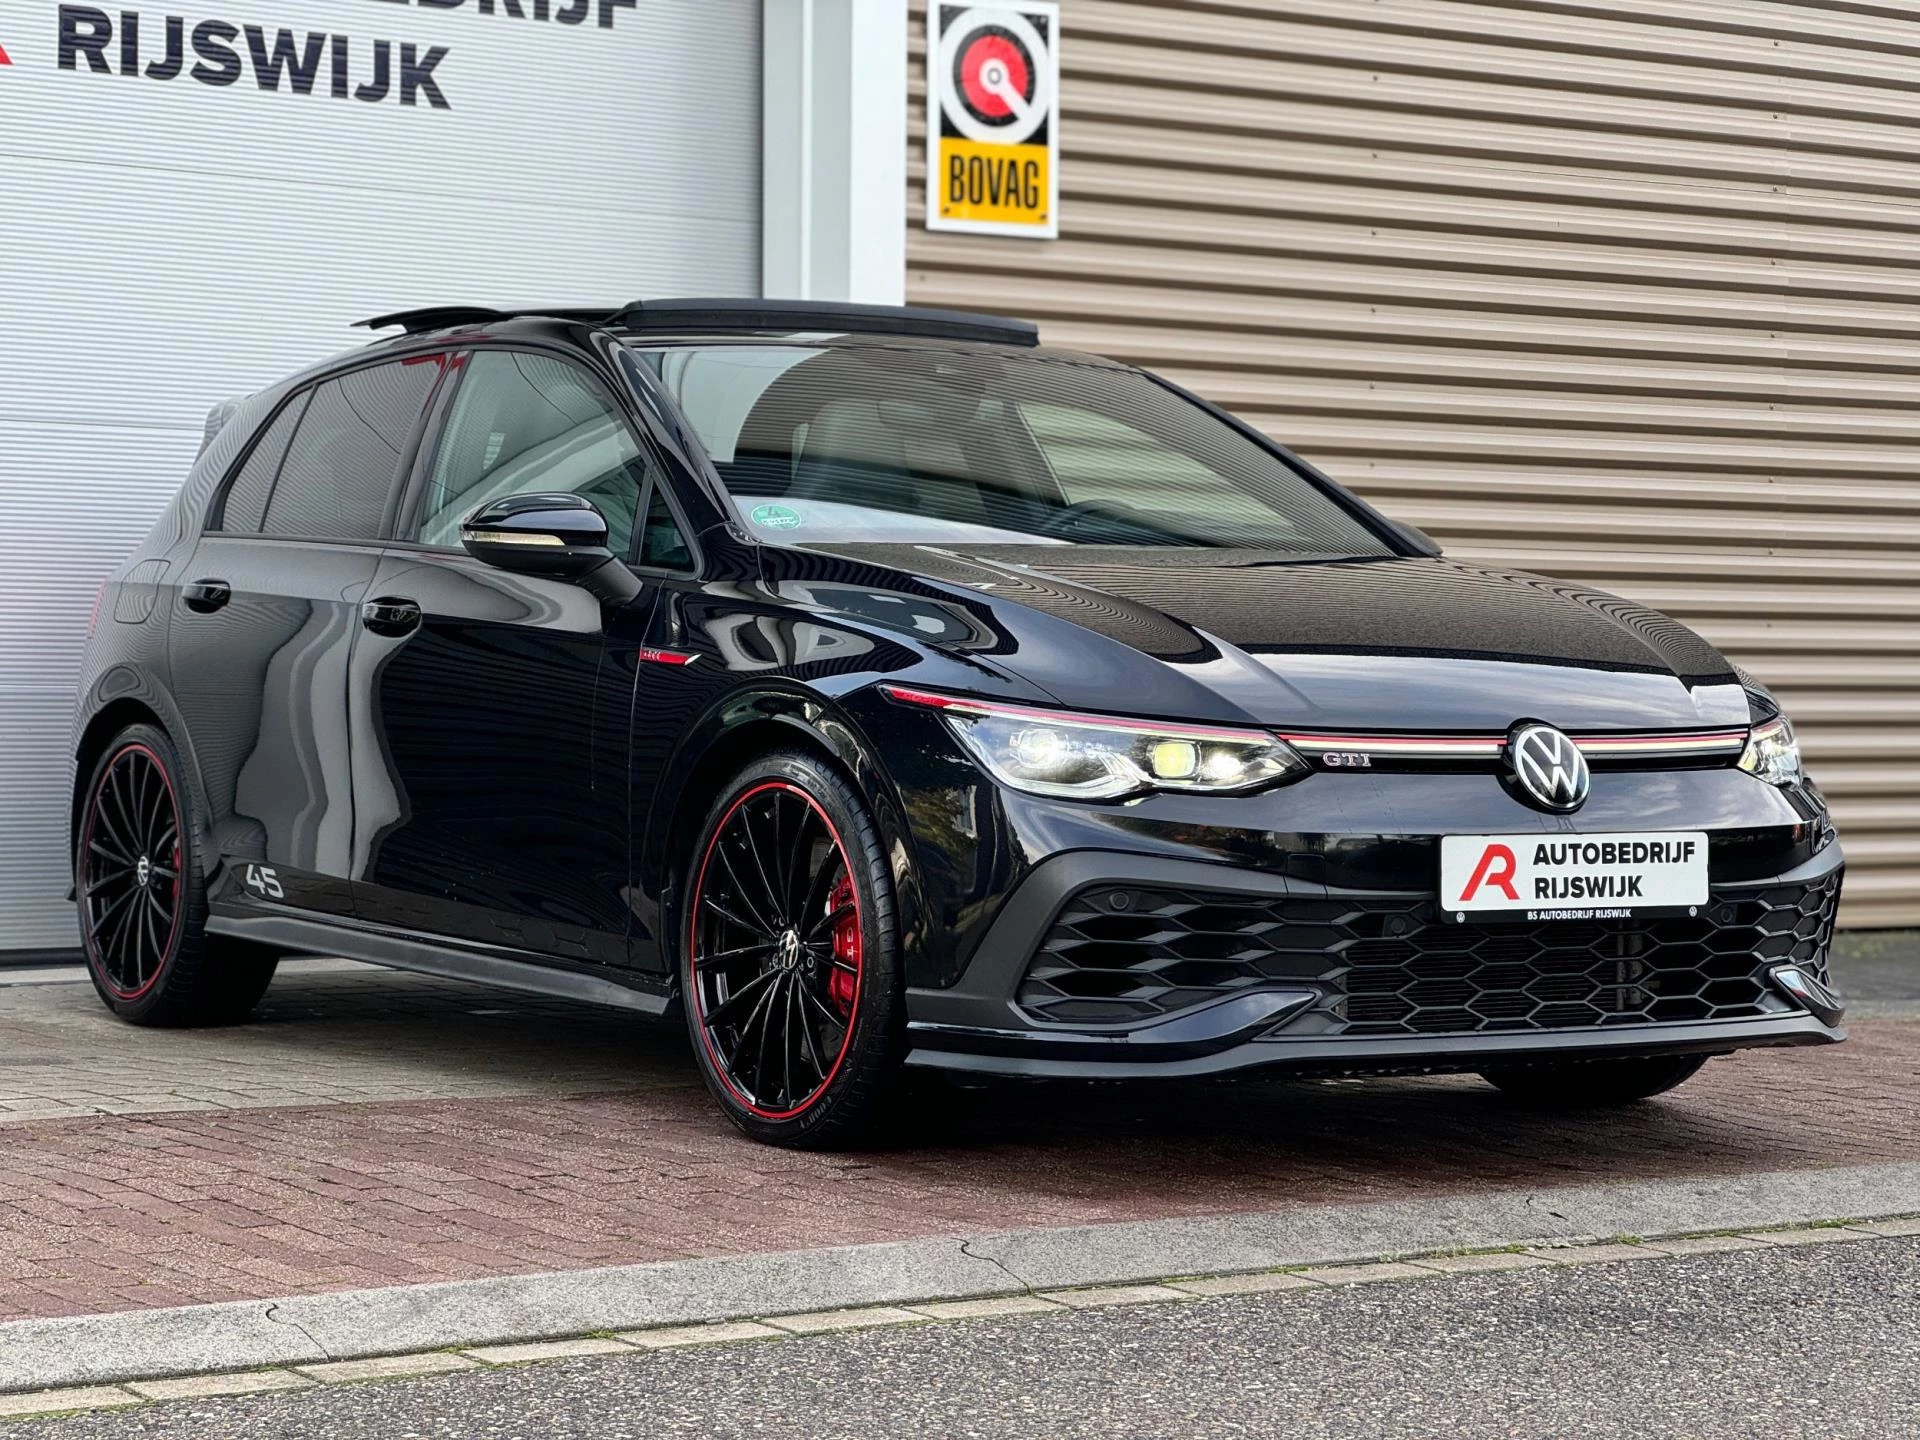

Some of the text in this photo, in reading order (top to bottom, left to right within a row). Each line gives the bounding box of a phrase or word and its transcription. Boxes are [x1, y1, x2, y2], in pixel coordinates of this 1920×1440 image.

[57, 4, 452, 109] RIJSWIJK
[949, 154, 1039, 209] BOVAG
[1322, 751, 1371, 767] GTI
[1533, 841, 1695, 866] AUTOBEDRIJF
[246, 864, 284, 898] 45
[1535, 875, 1643, 899] RIJSWIJK
[1527, 908, 1632, 920] BS AUTOBEDRIJF RIJSWIJK
